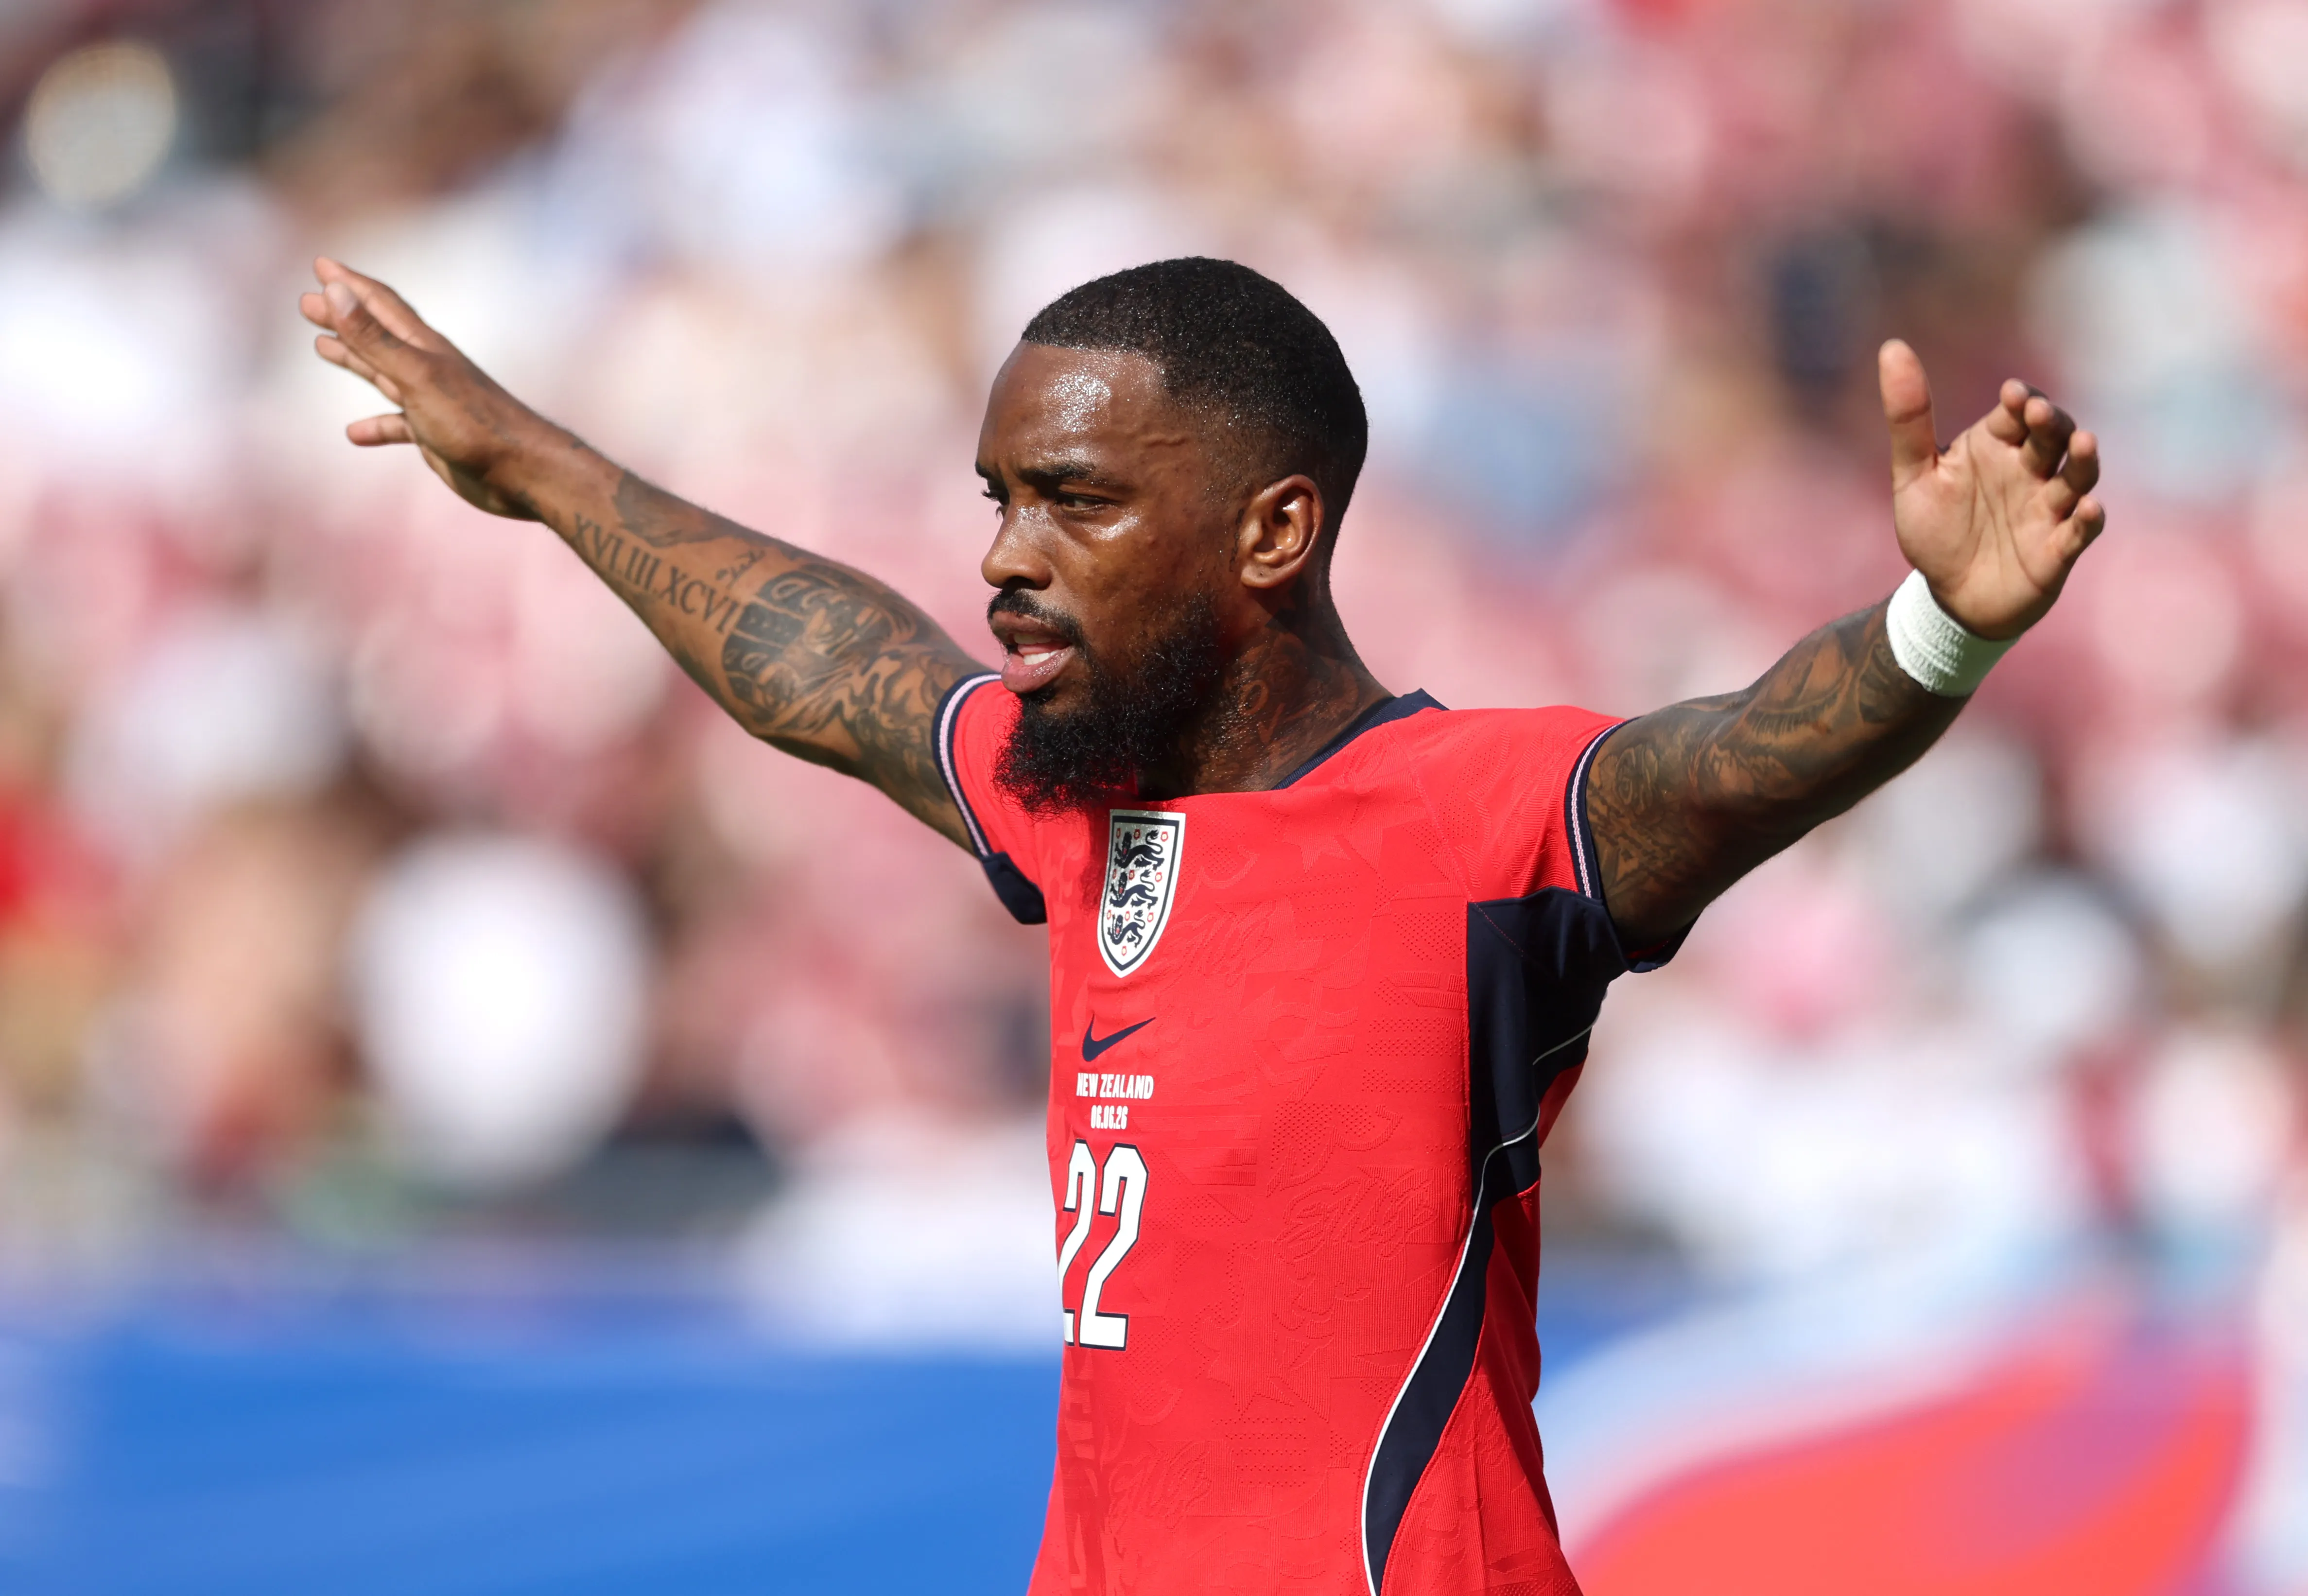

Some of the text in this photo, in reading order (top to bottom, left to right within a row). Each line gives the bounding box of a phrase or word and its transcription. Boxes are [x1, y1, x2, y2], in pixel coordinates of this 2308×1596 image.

[1076, 1073, 1154, 1099] NEW ZEALAND
[1091, 1105, 1128, 1130] 06.06.26
[1058, 1138, 1148, 1351] 22
